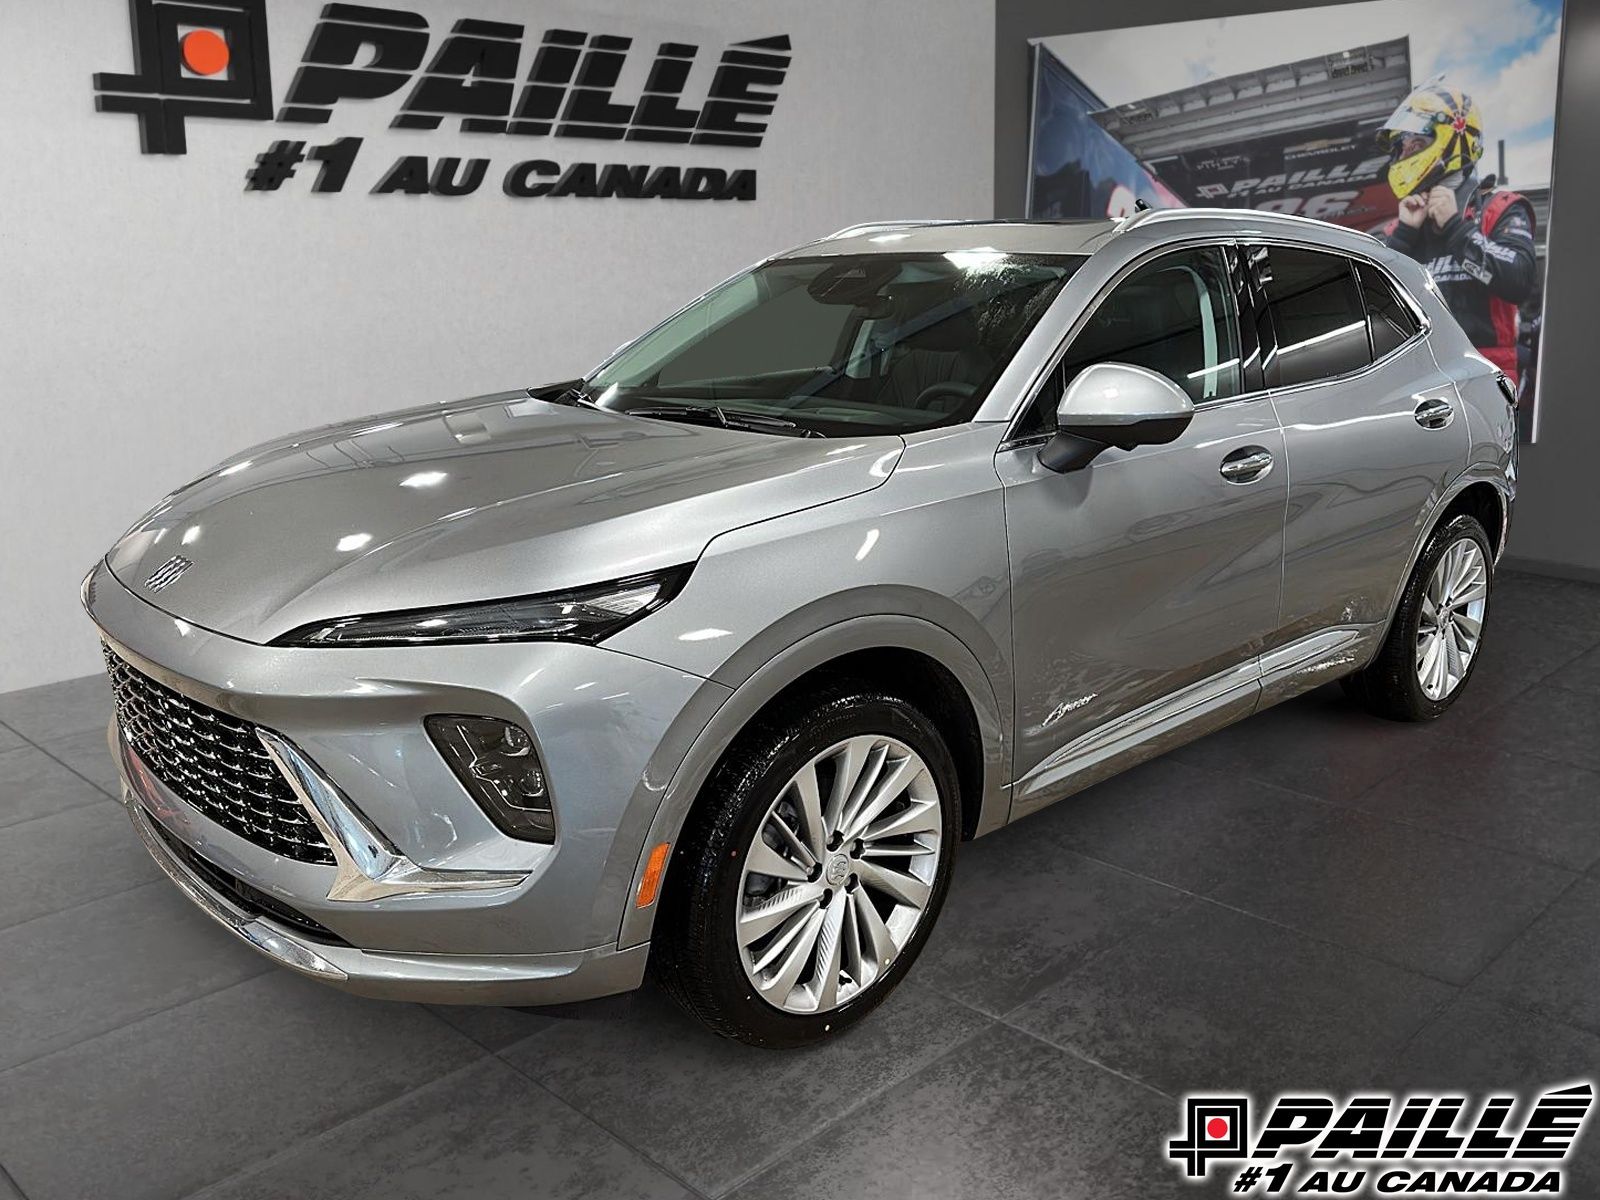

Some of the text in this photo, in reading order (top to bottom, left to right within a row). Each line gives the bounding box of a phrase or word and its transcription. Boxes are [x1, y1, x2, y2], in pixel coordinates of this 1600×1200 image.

[275, 2, 791, 148] PAILLÉ
[244, 136, 756, 200] #1 AU CANADA
